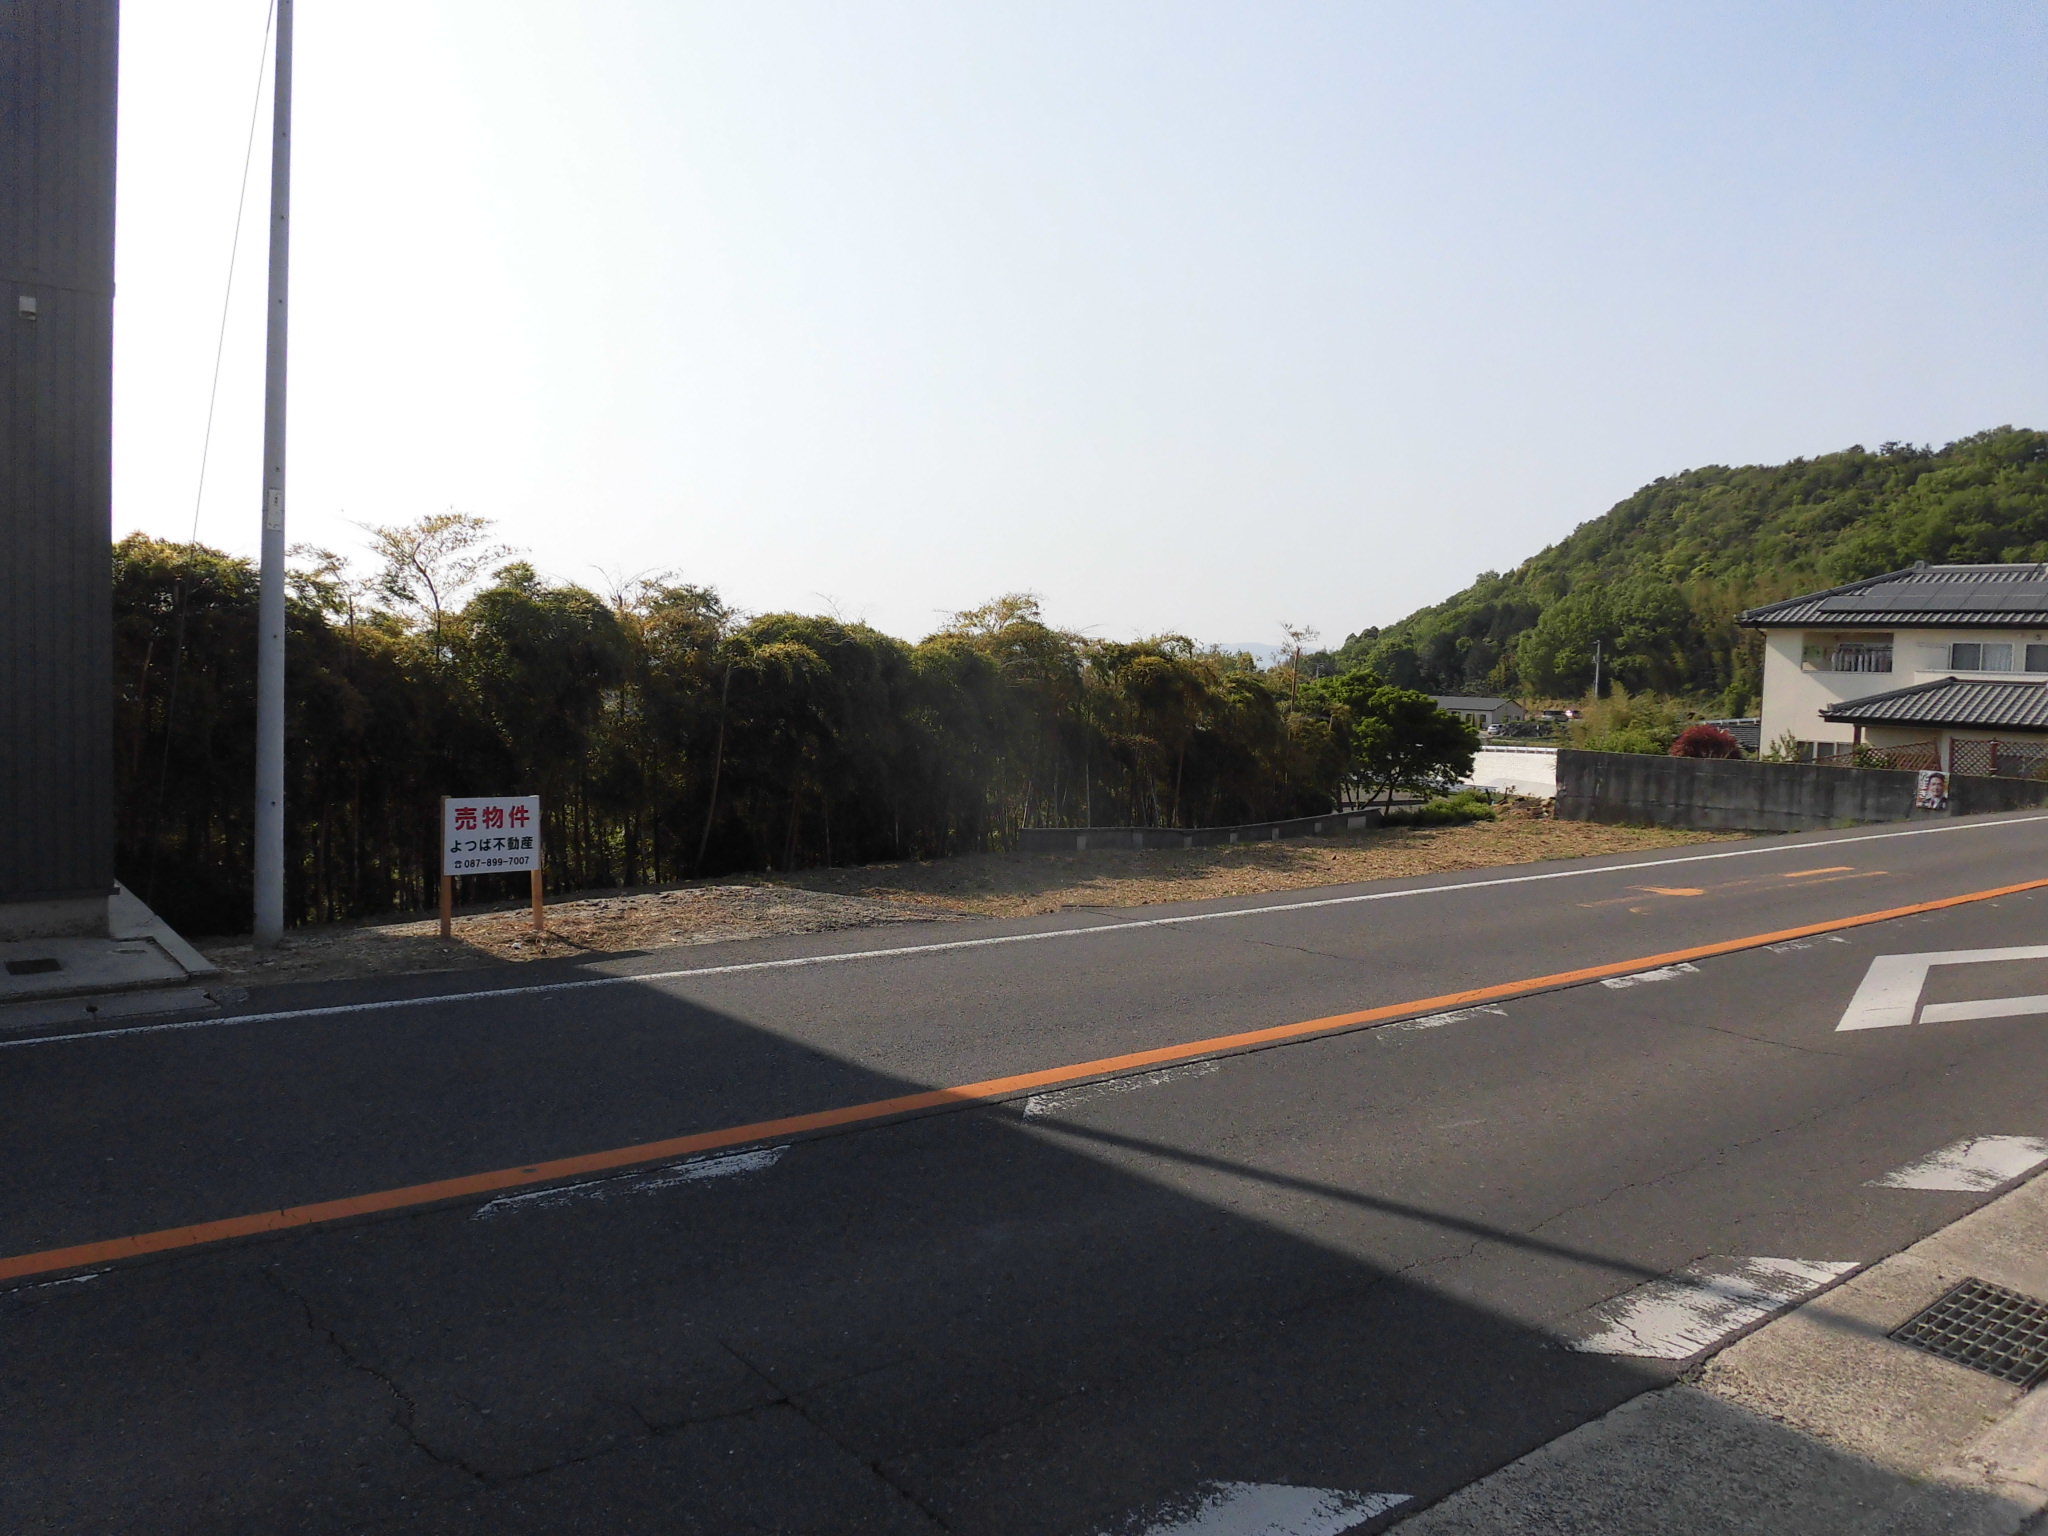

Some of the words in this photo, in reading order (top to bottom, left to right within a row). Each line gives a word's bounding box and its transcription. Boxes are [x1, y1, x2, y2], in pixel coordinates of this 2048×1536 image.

[455, 805, 530, 831] 売物件
[450, 836, 533, 853] よつば不動産
[464, 856, 529, 868] 087-899-7007
